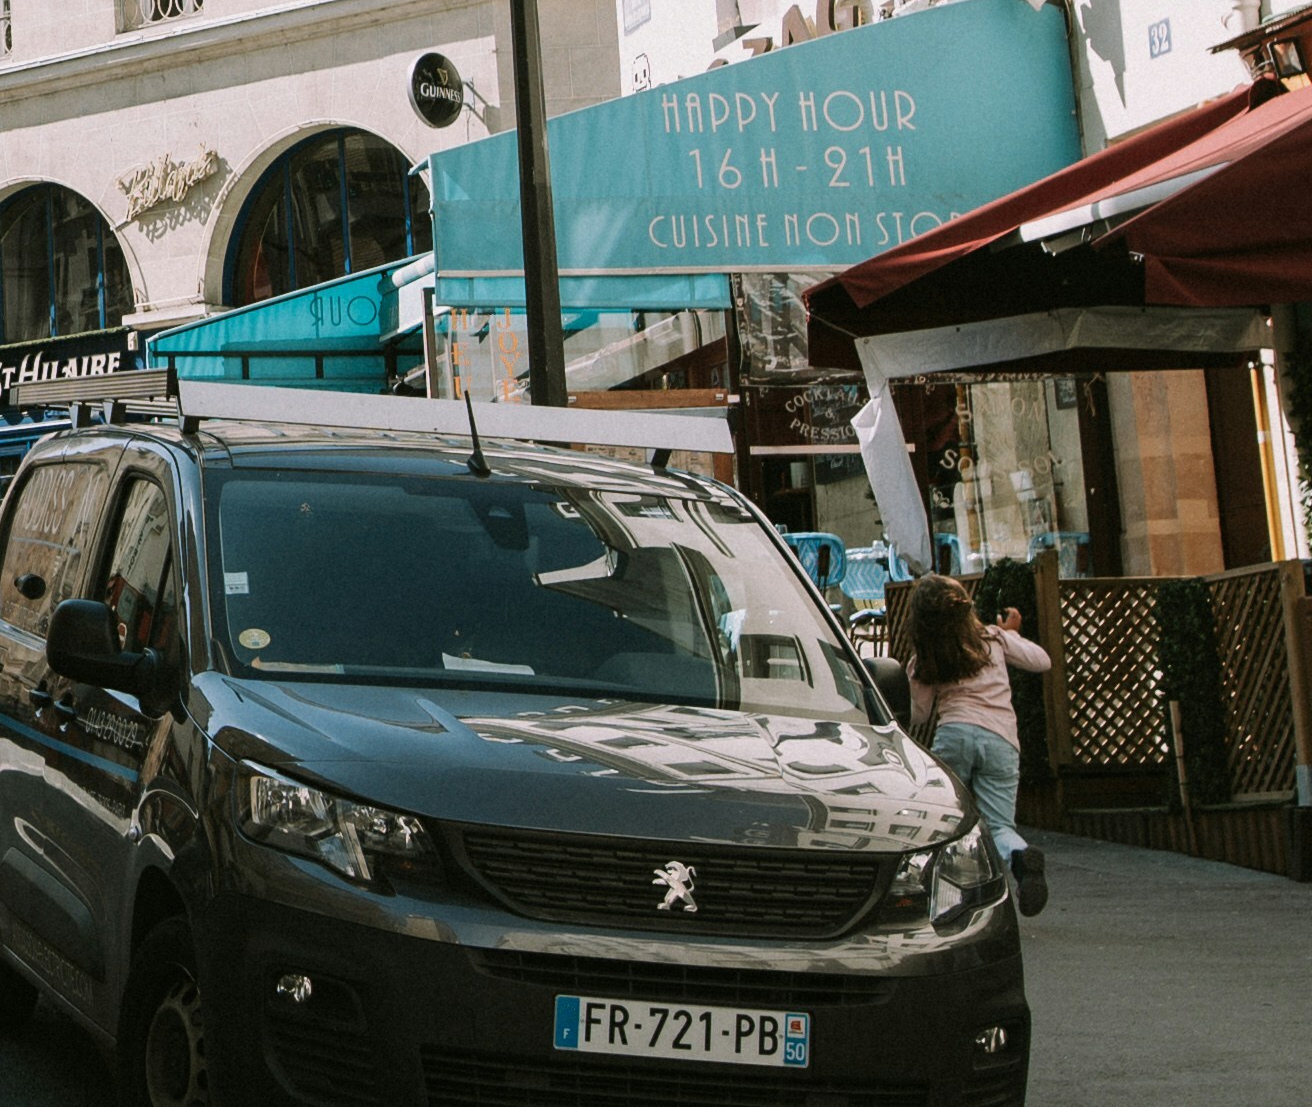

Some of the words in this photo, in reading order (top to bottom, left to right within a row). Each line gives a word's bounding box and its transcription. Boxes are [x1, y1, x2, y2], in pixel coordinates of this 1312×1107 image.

[1150, 22, 1170, 55] 32
[420, 82, 461, 103] GUINNESS
[661, 91, 780, 133] HAPPY
[798, 90, 917, 132] HOUR
[648, 213, 769, 248] CUISINE
[784, 212, 862, 245] NON
[789, 417, 856, 441] PRESSIO
[562, 1028, 571, 1040] F
[583, 1001, 779, 1056] FR-721-PB
[785, 1042, 806, 1062] 50
